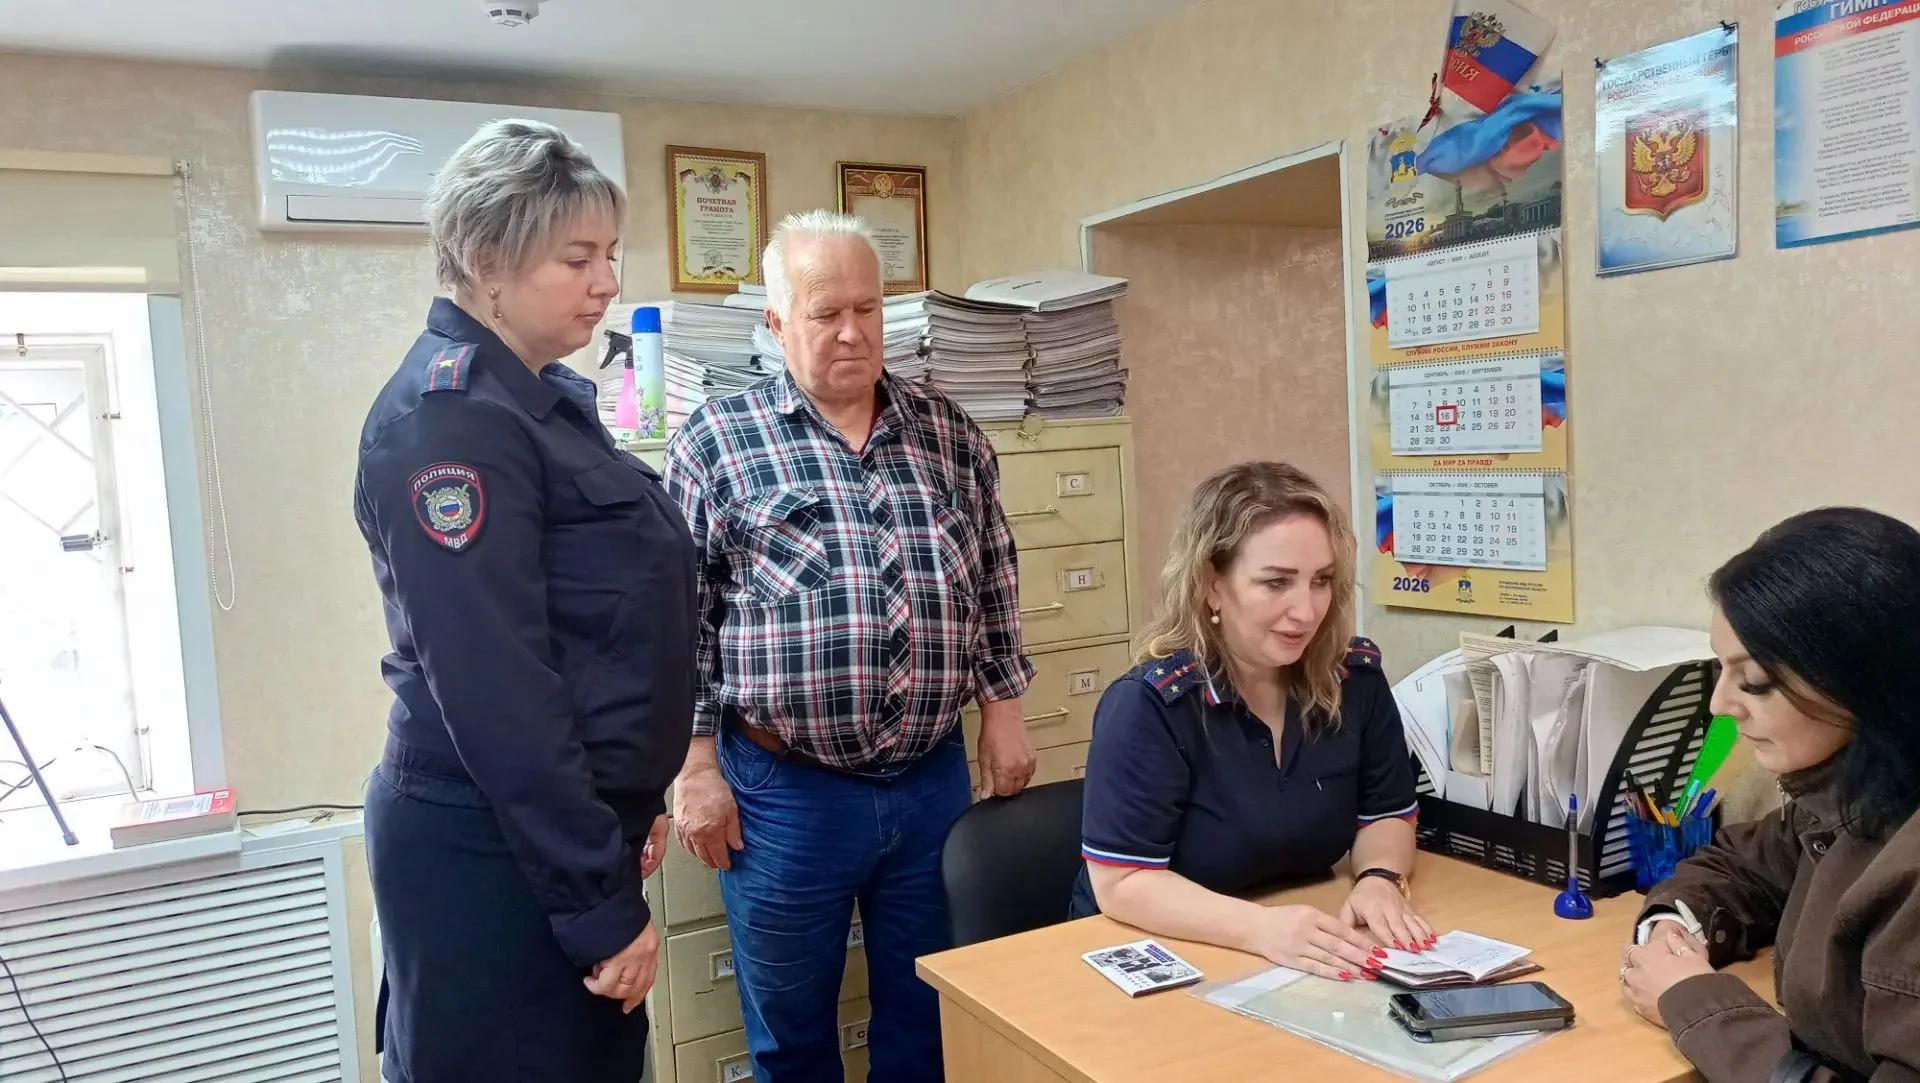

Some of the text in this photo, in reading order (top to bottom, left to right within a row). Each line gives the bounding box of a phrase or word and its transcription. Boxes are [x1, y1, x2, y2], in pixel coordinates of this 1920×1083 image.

[1703, 46, 1730, 63] ГЕРБ
[696, 197, 737, 206] ПОЧЕТНАЯ
[699, 205, 734, 214] ГРАМОТА
[1384, 217, 1425, 240] 2026
[1503, 265, 1509, 274] 2
[1408, 292, 1414, 301] 3
[1439, 288, 1445, 296] 5
[1454, 285, 1460, 294] 6
[1471, 283, 1477, 292] 7
[1487, 280, 1493, 289] 8
[1503, 278, 1510, 286] 9
[1407, 290, 1512, 312] 10 11 12 13 14 15 16
[1407, 303, 1512, 325] 17 18 19 20 21 22 23
[1421, 326, 1432, 335] 25
[1437, 324, 1448, 333] 26
[1452, 322, 1463, 331] 27
[1468, 320, 1479, 330] 28
[1484, 318, 1496, 328] 29
[1500, 316, 1513, 325] 30
[1405, 346, 1432, 357] СЛУЖИМ
[1461, 341, 1491, 352] СЛУЖИМ
[1492, 338, 1519, 348] ЗАКОНУ
[1441, 387, 1448, 396] 2
[1457, 386, 1463, 395] 3
[1490, 384, 1496, 393] 5
[1506, 383, 1513, 392] 6
[1412, 401, 1418, 410] 7
[1427, 400, 1432, 409] 8
[1456, 398, 1466, 407] 10
[1472, 398, 1481, 406] 11
[1488, 396, 1499, 405] 12
[1505, 395, 1516, 404] 13
[1425, 412, 1435, 421] 15
[1440, 412, 1450, 420] 16
[1472, 410, 1482, 419] 18
[1489, 409, 1499, 418] 19
[1504, 408, 1516, 417] 20
[1410, 425, 1419, 434] 21
[1424, 424, 1435, 433] 22
[1455, 423, 1466, 432] 24
[1471, 422, 1482, 431] 25
[1487, 422, 1499, 430] 26
[1504, 420, 1516, 430] 27
[1410, 436, 1451, 446] 28 29 30
[1467, 458, 1493, 467] ПРАВДУ
[413, 467, 476, 492] ПОЛИЦИЯ
[1475, 499, 1481, 508] 2
[1491, 499, 1498, 508] 3
[1414, 510, 1516, 521] 5 6 7 8 9 10 11
[1412, 521, 1422, 530] 12
[1427, 522, 1436, 530] 13
[1458, 523, 1468, 532] 15
[1473, 524, 1484, 532] 16
[1490, 524, 1500, 533] 17
[1506, 525, 1517, 534] 18
[443, 533, 468, 549] МВД
[1412, 533, 1518, 546] 19 20 21 22 23 24 25
[1411, 544, 1499, 558] 26 27 28 29 30 31
[1392, 576, 1430, 593] 2026
[1080, 677, 1091, 688] М
